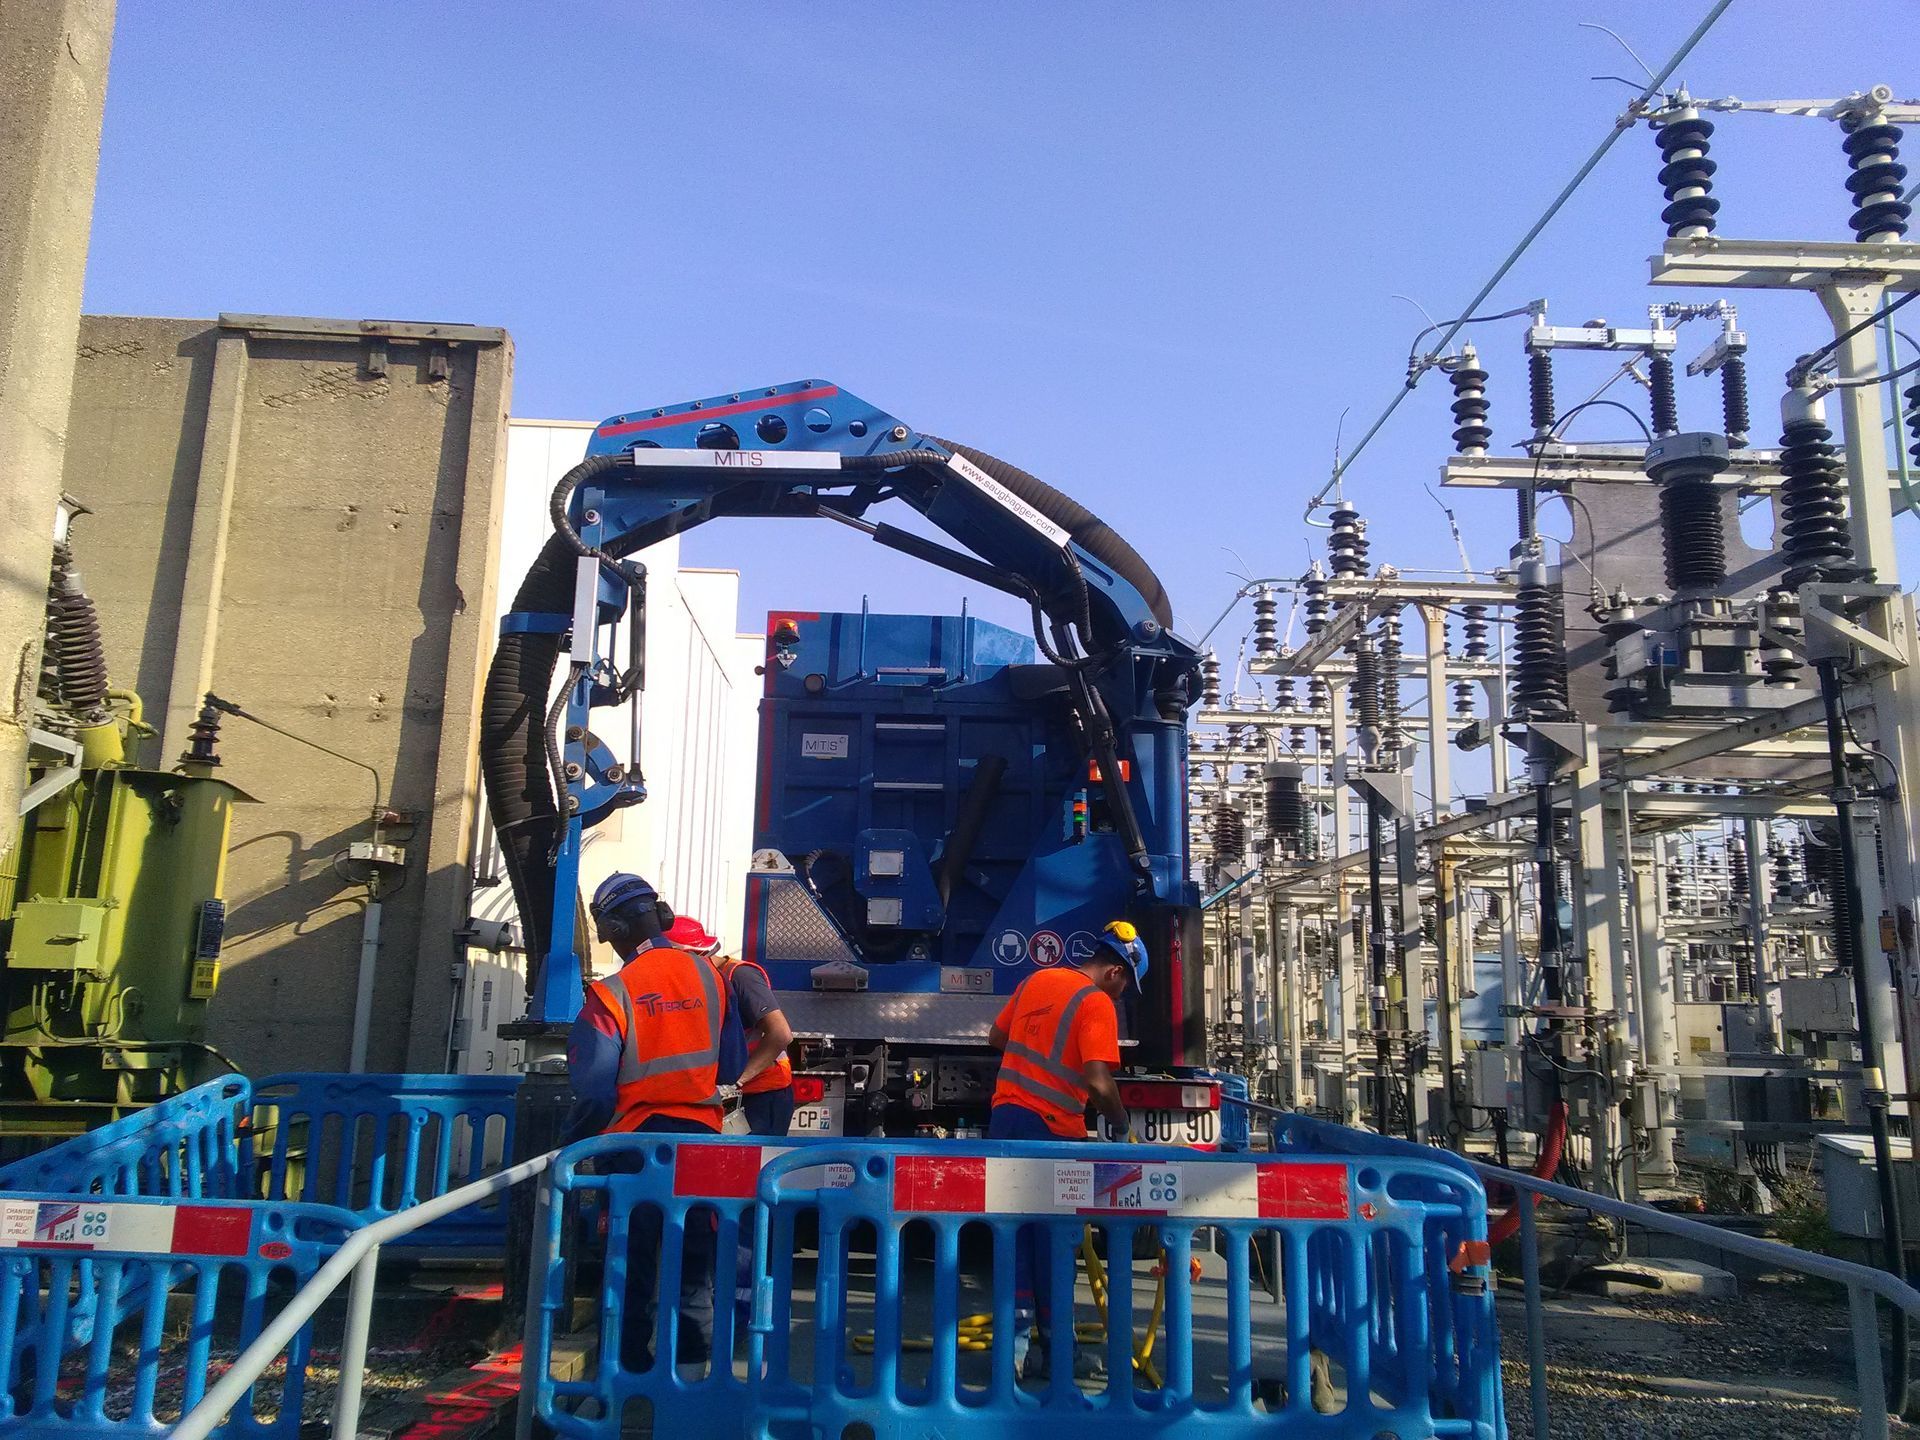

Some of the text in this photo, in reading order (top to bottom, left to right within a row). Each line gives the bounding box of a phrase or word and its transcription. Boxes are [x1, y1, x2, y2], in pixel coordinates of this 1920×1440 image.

[961, 463, 1056, 536] www.saugbagger.com
[1144, 1109, 1172, 1142] 80
[1186, 1110, 1214, 1143] 90
[1056, 1169, 1091, 1177] CHANTIER
[1061, 1193, 1086, 1201] PUBLIC
[1068, 1185, 1079, 1193] AU
